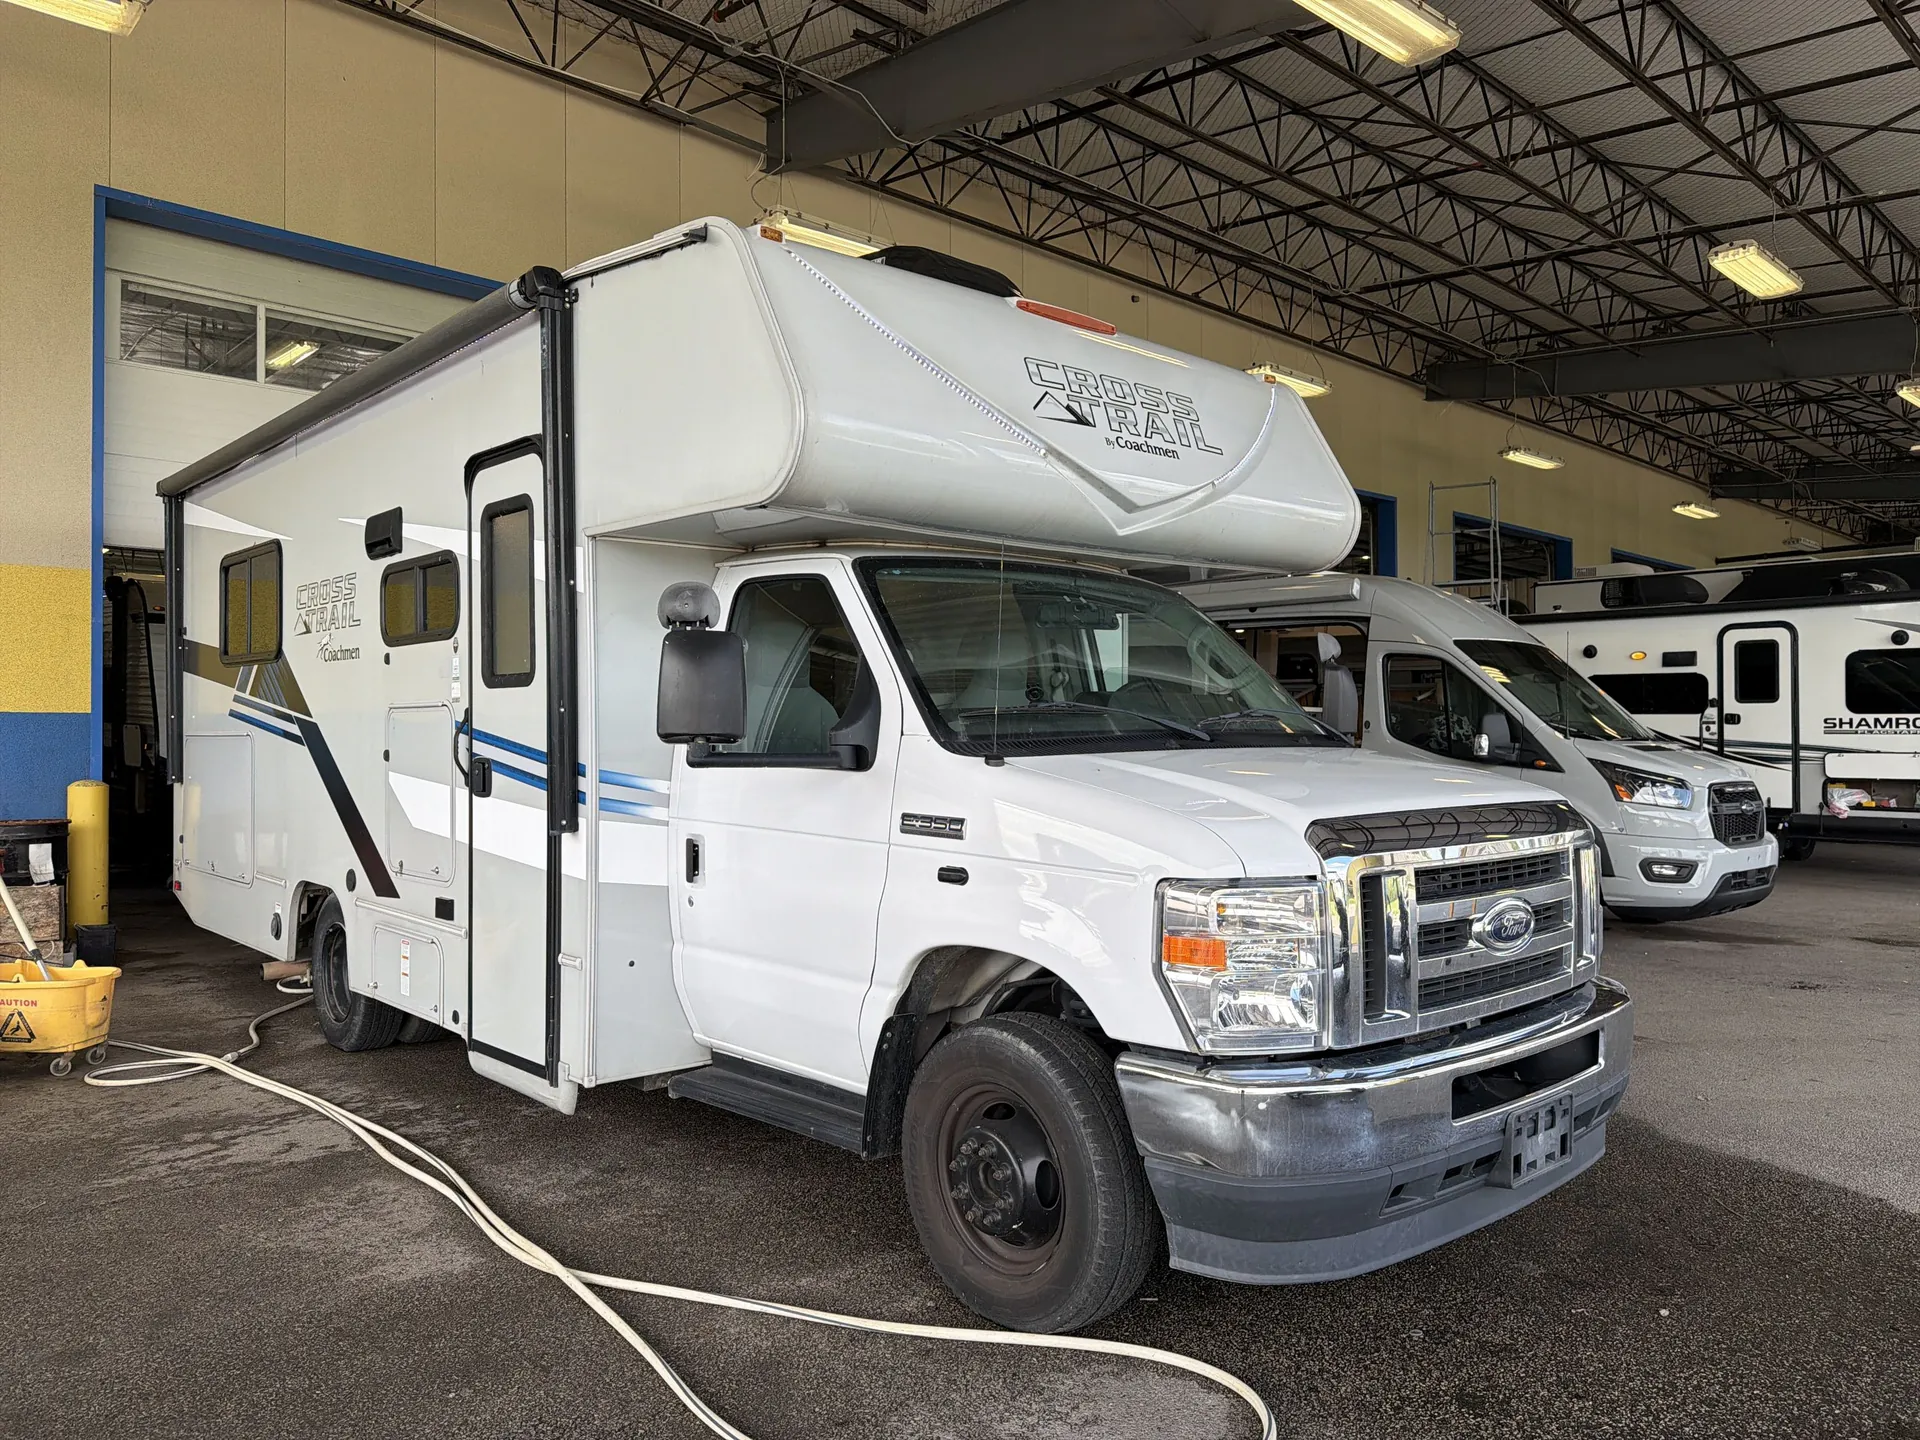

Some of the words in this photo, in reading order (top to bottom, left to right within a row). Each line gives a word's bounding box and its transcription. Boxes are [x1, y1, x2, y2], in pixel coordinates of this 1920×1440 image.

[1024, 357, 1199, 422] CROSS
[1067, 394, 1223, 455] TRAIL
[1104, 436, 1115, 450] By
[1115, 437, 1180, 460] Coachmen
[296, 572, 357, 610] CROSS
[305, 601, 361, 633] TRAIL
[323, 645, 360, 662] Coachmen
[1501, 914, 1526, 937] Ford
